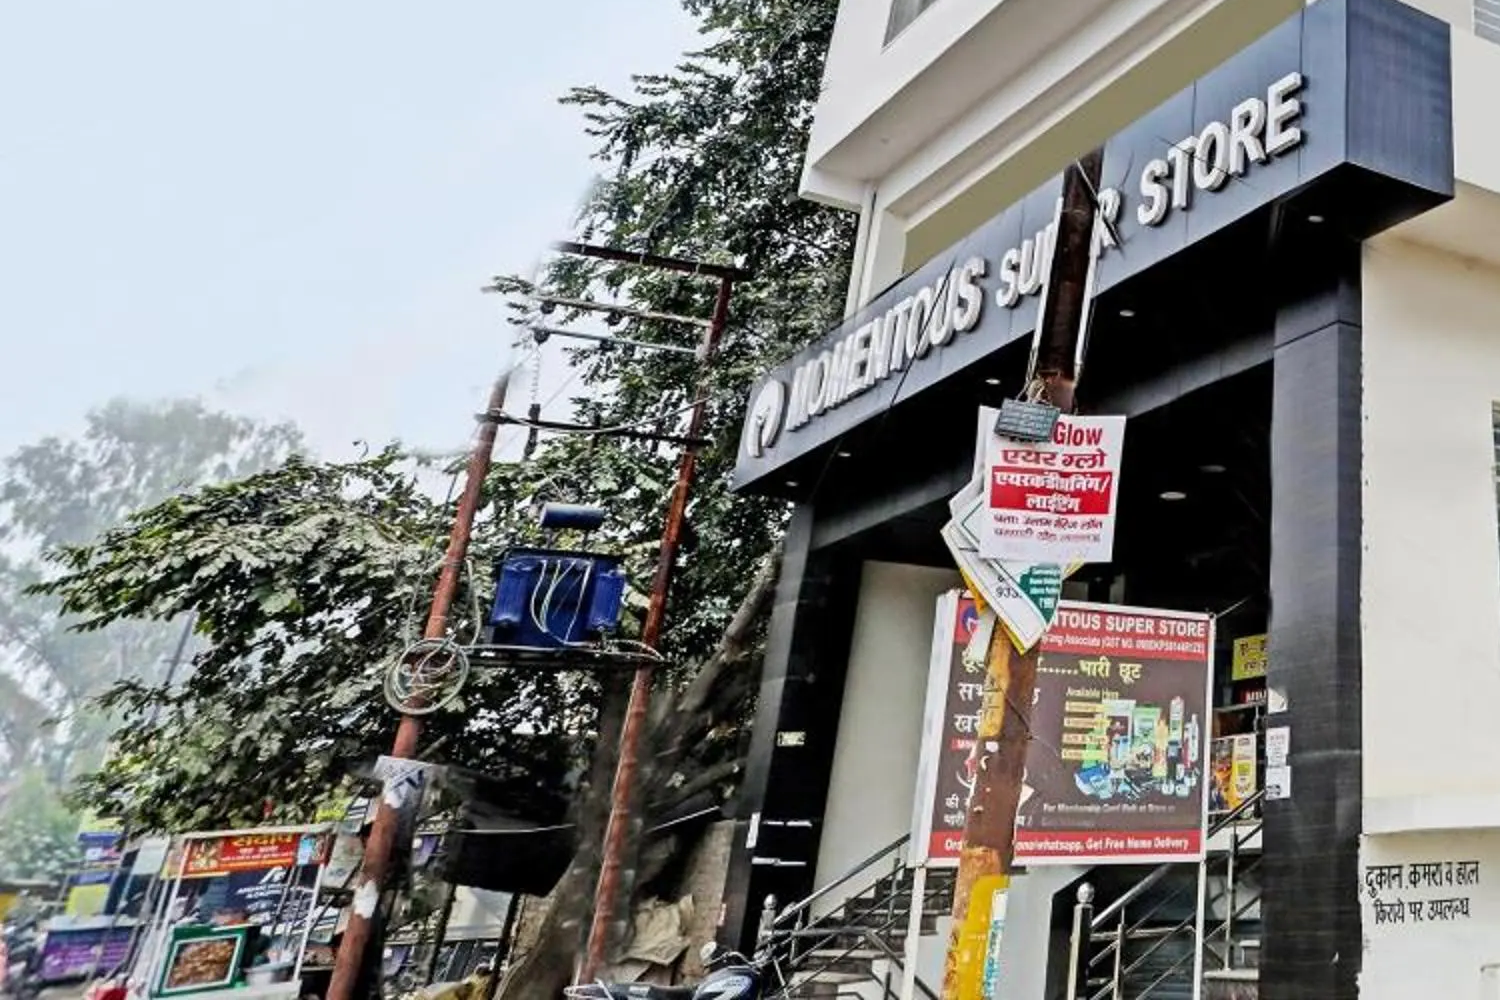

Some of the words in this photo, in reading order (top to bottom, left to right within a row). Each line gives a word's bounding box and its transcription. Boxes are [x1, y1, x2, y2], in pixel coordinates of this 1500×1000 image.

[784, 255, 988, 432] MOMENTOUS
[995, 186, 1121, 308] SUR
[1138, 71, 1303, 227] STORE
[1053, 421, 1103, 447] Glow
[1001, 449, 1056, 466] एयर
[1061, 448, 1108, 469] ग्लो
[1106, 616, 1155, 634] SUPER
[1159, 619, 1206, 637] STORE
[1085, 838, 1101, 849] Get
[1104, 837, 1125, 849] Free
[1154, 836, 1189, 849] Delivery
[1408, 861, 1443, 888] कमरा
[1444, 862, 1453, 886] व
[1456, 860, 1480, 886] हाल
[1408, 901, 1424, 923] पर
